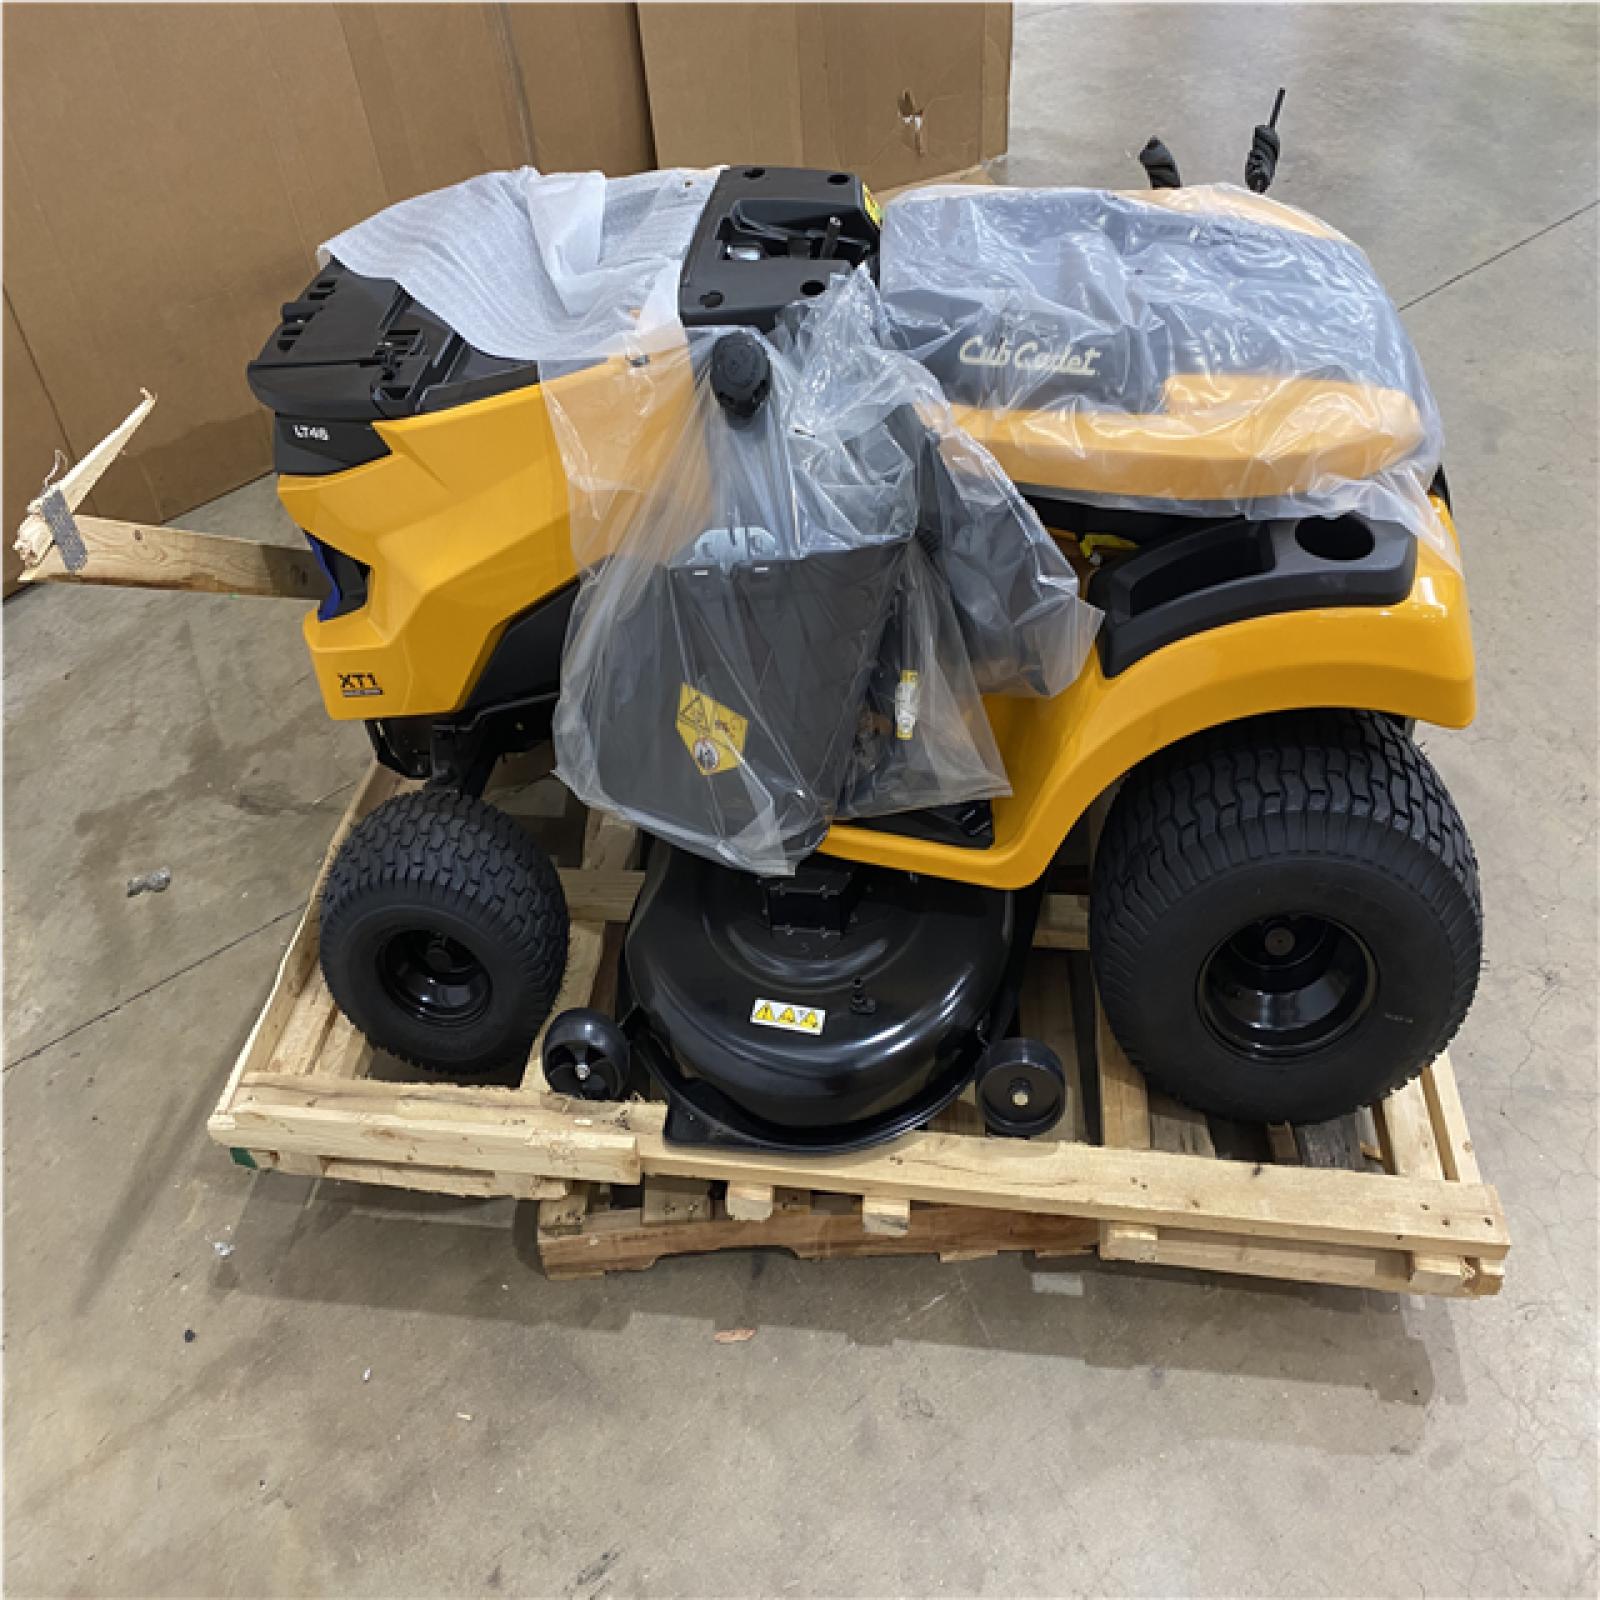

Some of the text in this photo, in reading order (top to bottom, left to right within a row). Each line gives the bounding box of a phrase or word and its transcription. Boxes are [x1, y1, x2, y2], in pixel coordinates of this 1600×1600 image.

[960, 335, 1102, 375] Cub Cadet
[338, 672, 376, 688] XT1
